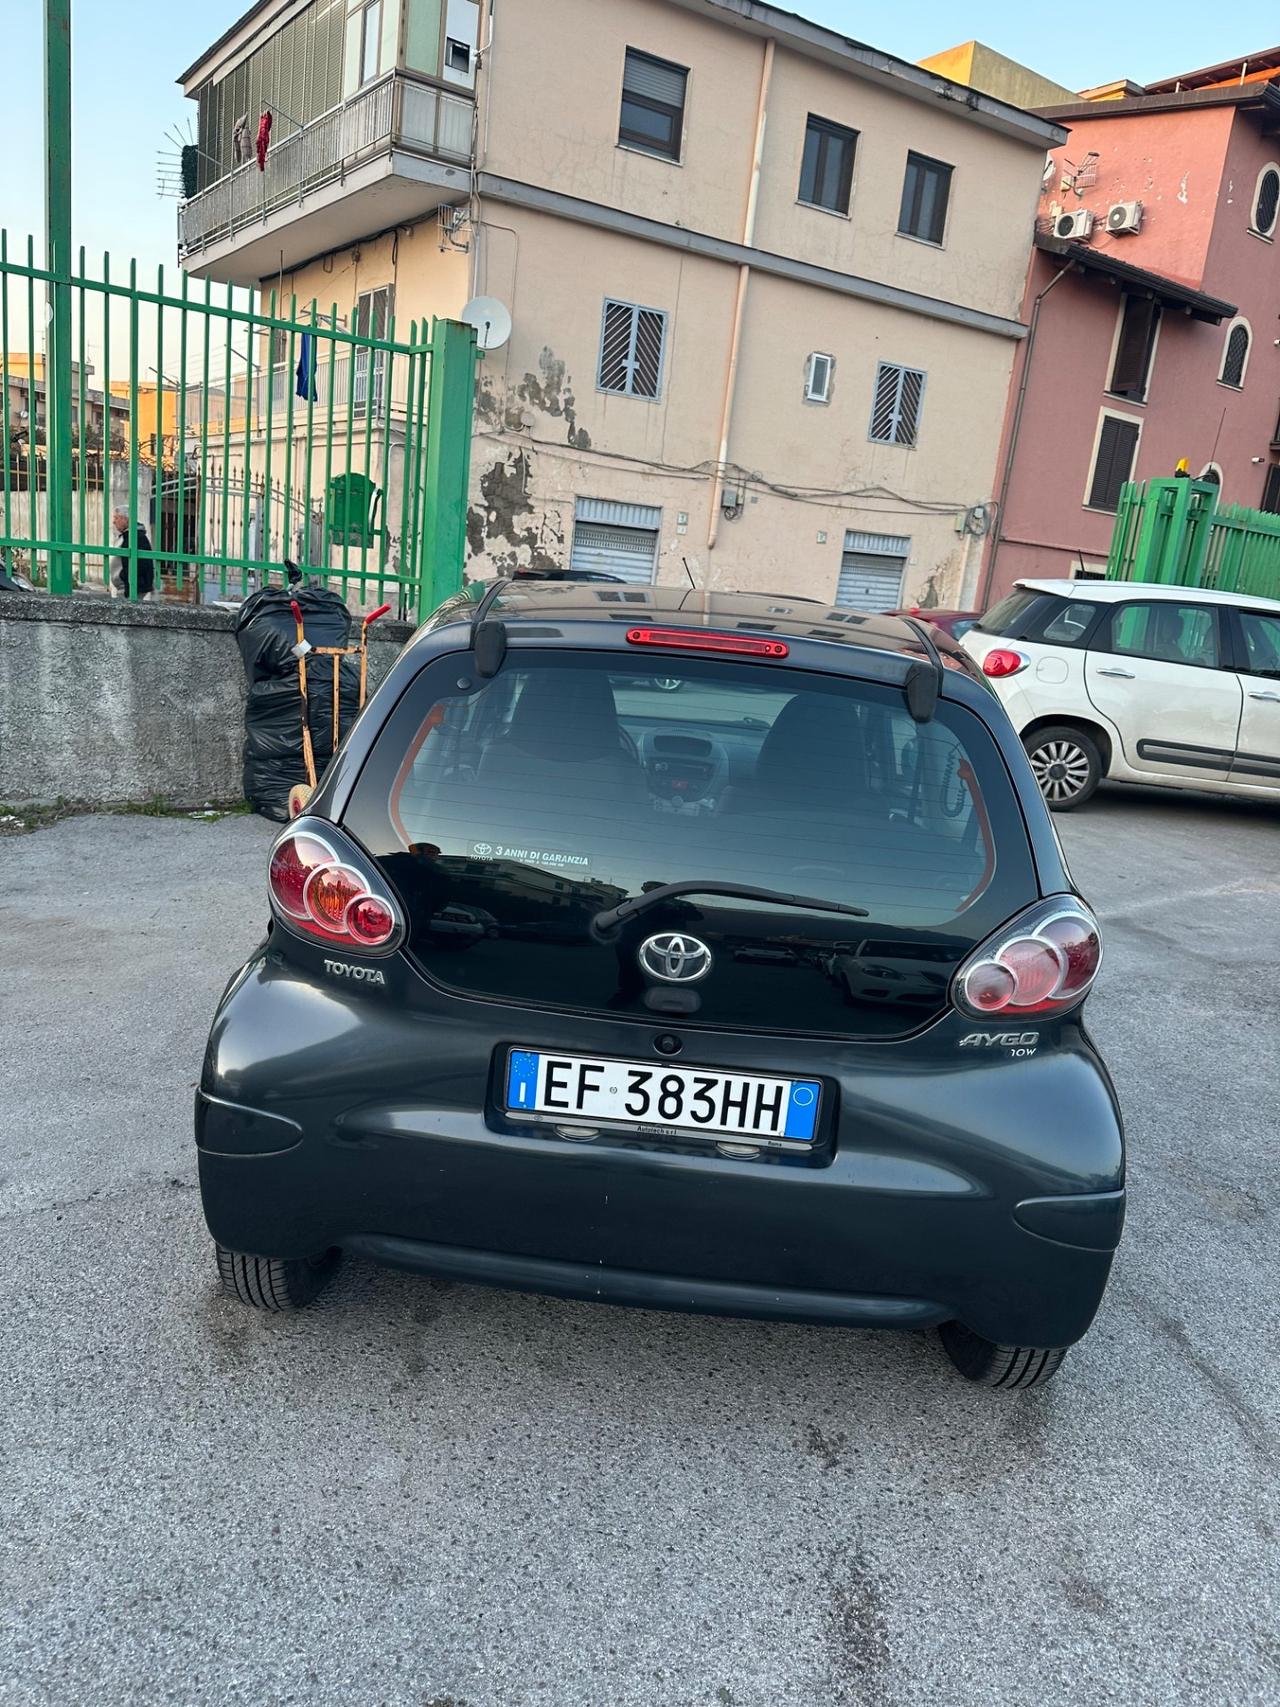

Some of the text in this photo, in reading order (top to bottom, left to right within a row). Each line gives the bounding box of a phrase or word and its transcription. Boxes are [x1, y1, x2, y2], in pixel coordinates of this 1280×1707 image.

[495, 846, 503, 856] 3
[503, 848, 528, 858] ANNI
[530, 851, 540, 860] DI
[542, 852, 589, 865] GARANZIA
[324, 959, 385, 984] TOYOTA
[959, 1032, 1040, 1047] AYGO
[544, 1060, 605, 1110] EF
[624, 1069, 784, 1132] 383HH
